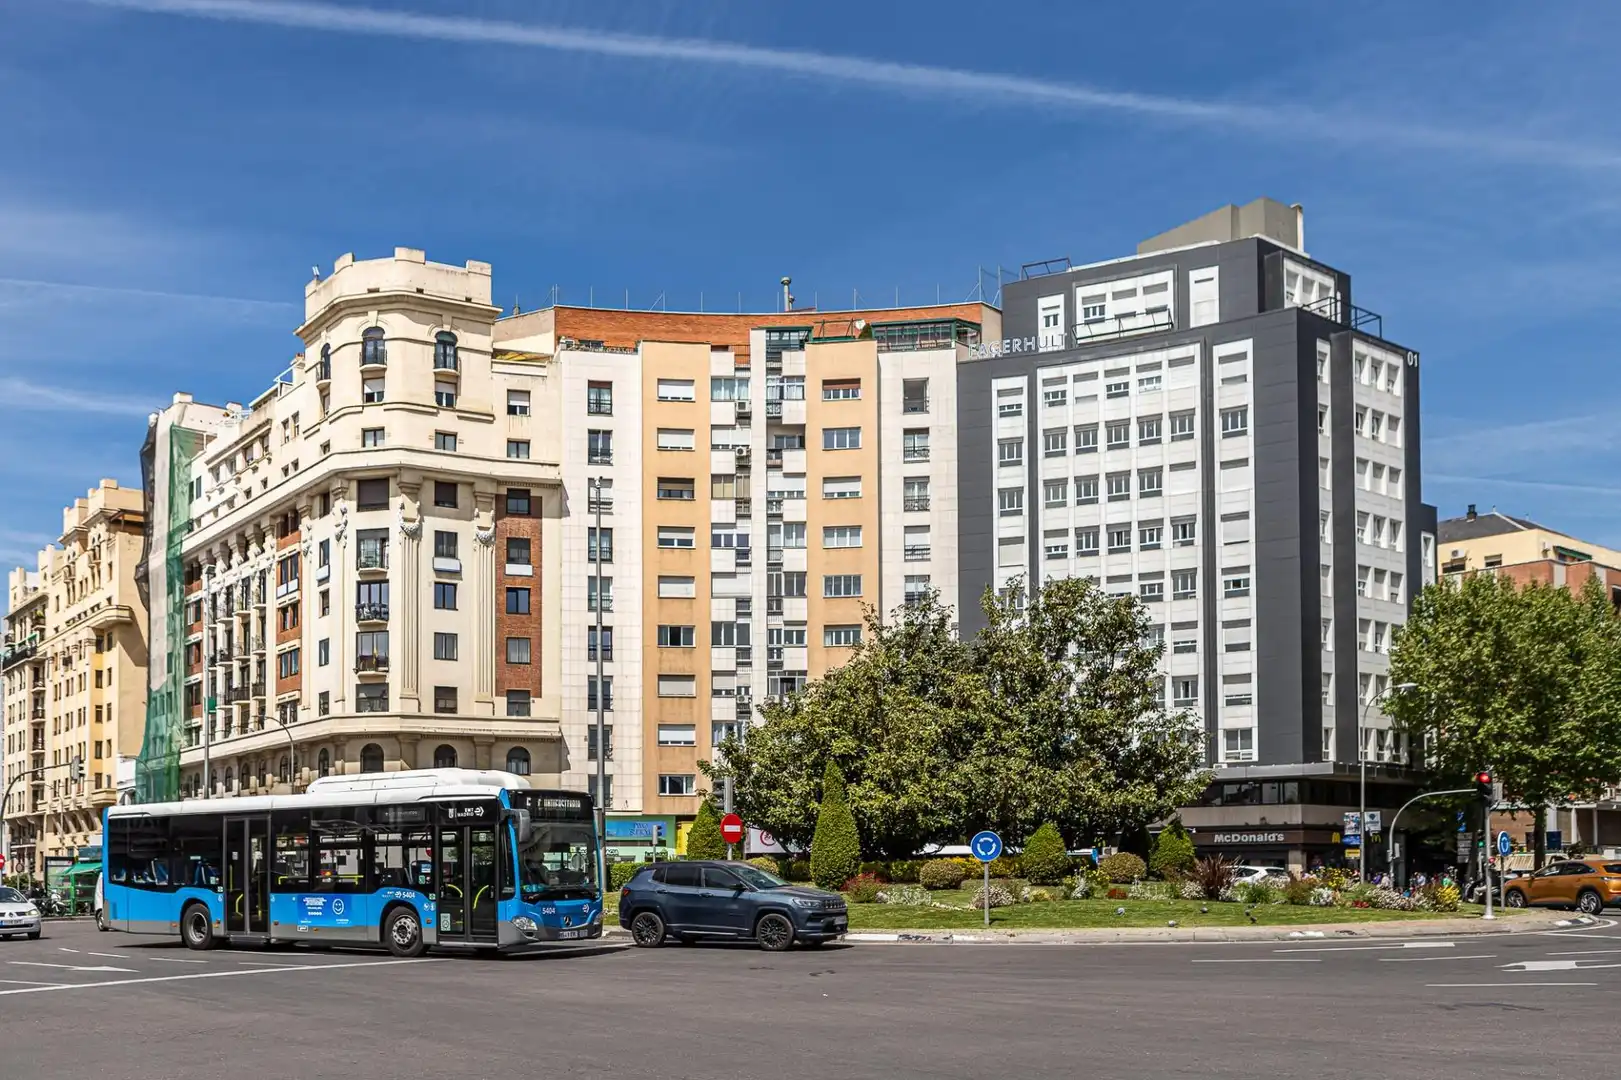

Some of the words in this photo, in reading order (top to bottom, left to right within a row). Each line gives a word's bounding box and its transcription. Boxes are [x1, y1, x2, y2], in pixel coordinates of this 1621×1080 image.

[968, 333, 1067, 359] FAGERHULT
[1407, 351, 1418, 367] 01
[1214, 833, 1285, 843] McDonald's
[402, 891, 416, 899] 5404
[542, 907, 556, 915] 5404
